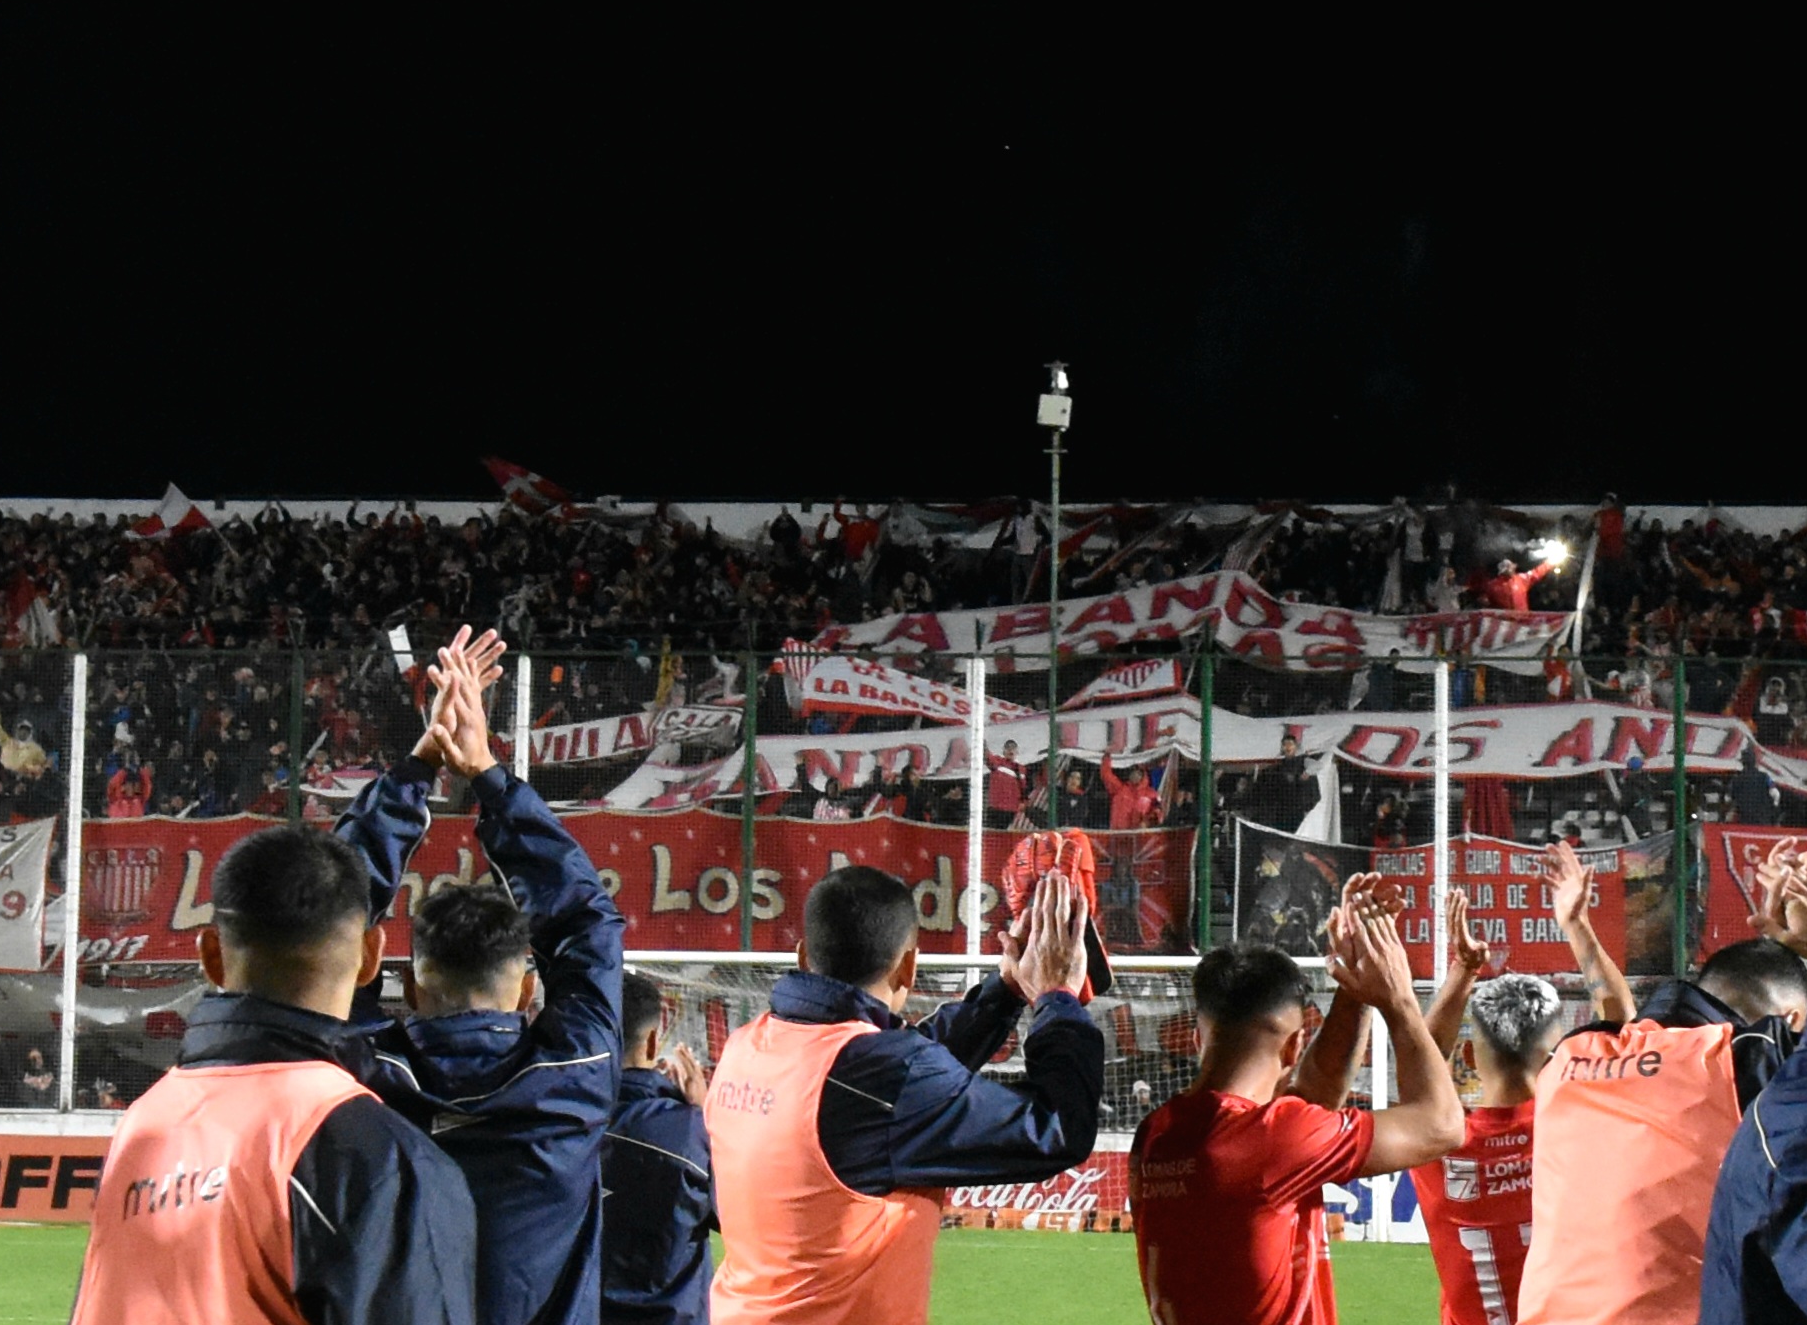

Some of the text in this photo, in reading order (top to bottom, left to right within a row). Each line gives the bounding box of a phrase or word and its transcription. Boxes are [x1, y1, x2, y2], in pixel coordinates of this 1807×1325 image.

[1465, 850, 1502, 876] GUIAR
[650, 841, 786, 923] Los
[1506, 883, 1529, 910] DE
[1404, 918, 1431, 944] LA
[1561, 1049, 1663, 1082] mitre
[715, 1080, 777, 1117] mitre
[1484, 1132, 1529, 1148] mitre
[121, 1163, 228, 1222] mitre
[1141, 1181, 1188, 1199] ZAMORA
